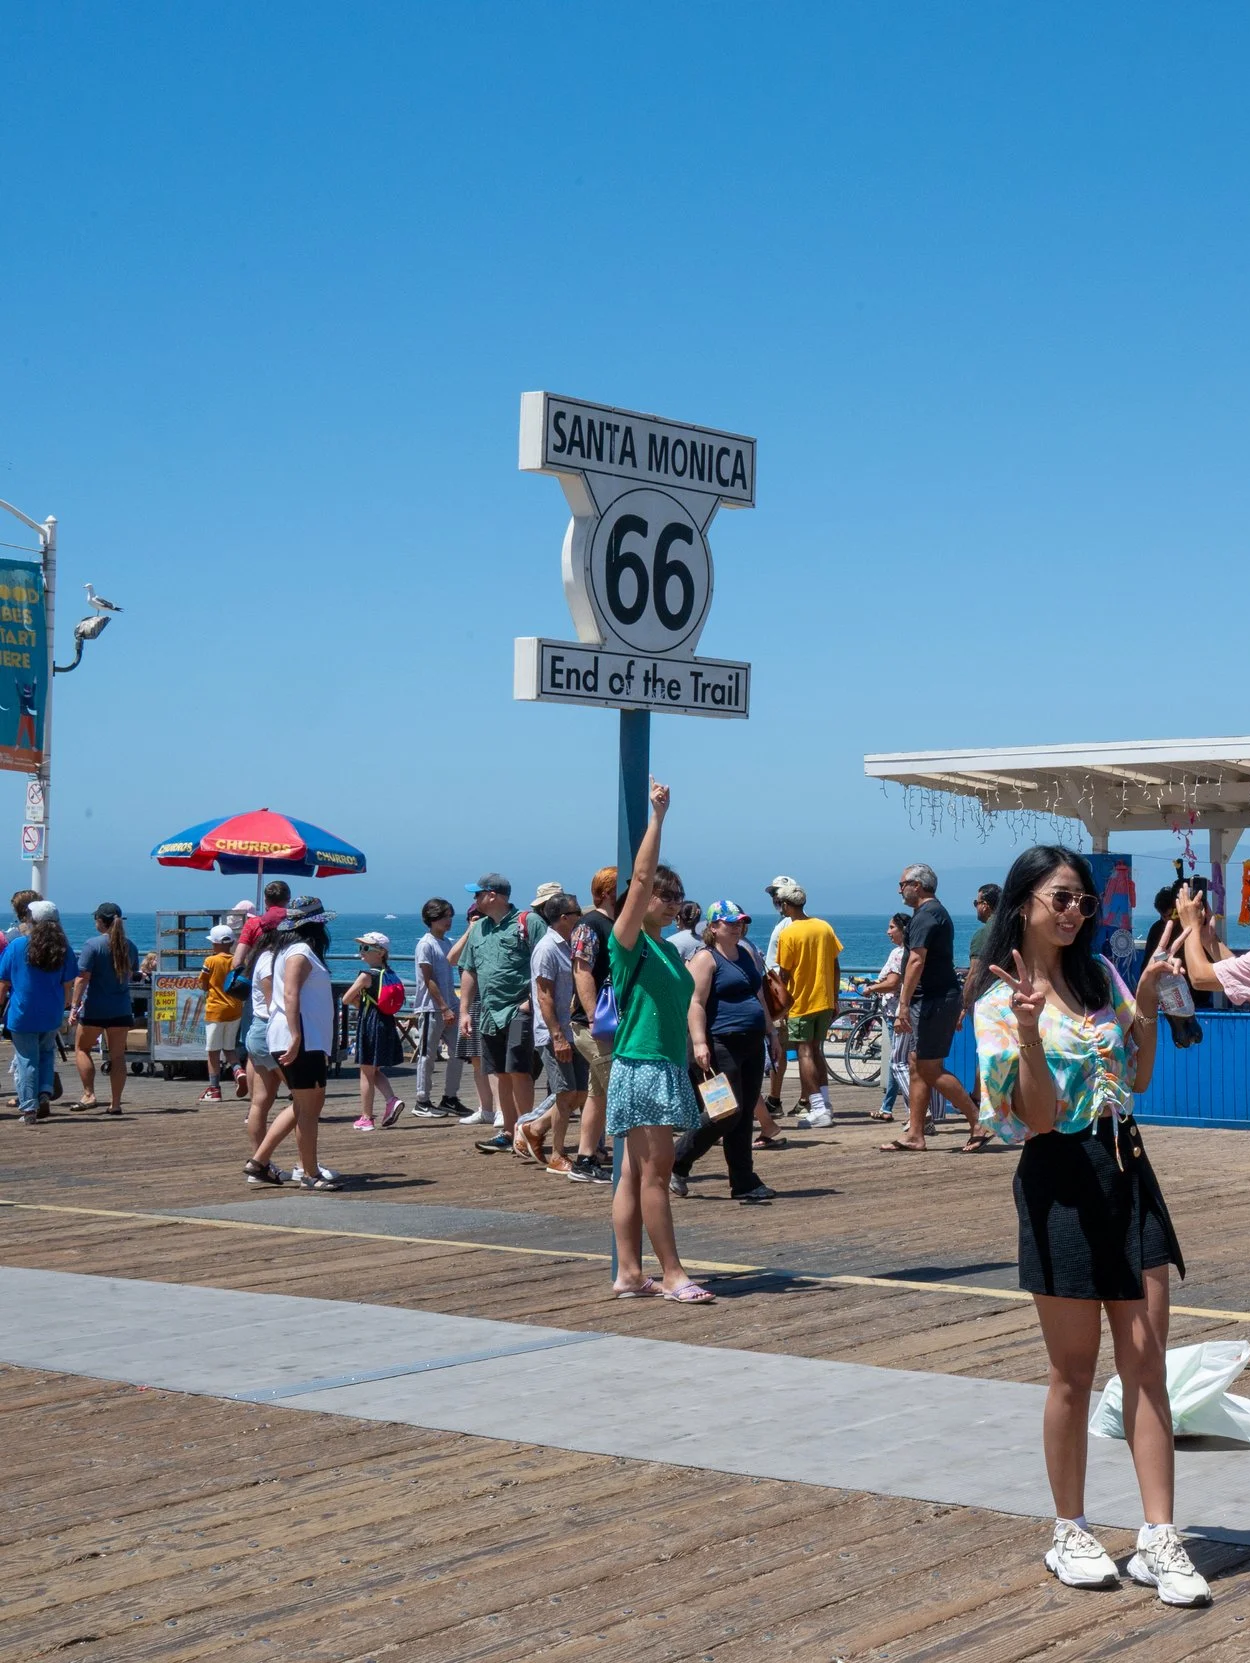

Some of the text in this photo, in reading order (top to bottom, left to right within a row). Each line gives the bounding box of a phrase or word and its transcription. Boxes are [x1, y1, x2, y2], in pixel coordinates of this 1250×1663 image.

[552, 410, 748, 490] SANTA MONICA
[605, 513, 695, 631] 66
[0, 650, 31, 668] ERE
[550, 655, 740, 707] End of the Trail
[157, 842, 193, 854] CHURROS
[215, 840, 291, 854] CHURROS
[316, 851, 358, 866] CHURROS
[156, 976, 203, 990] CHURR
